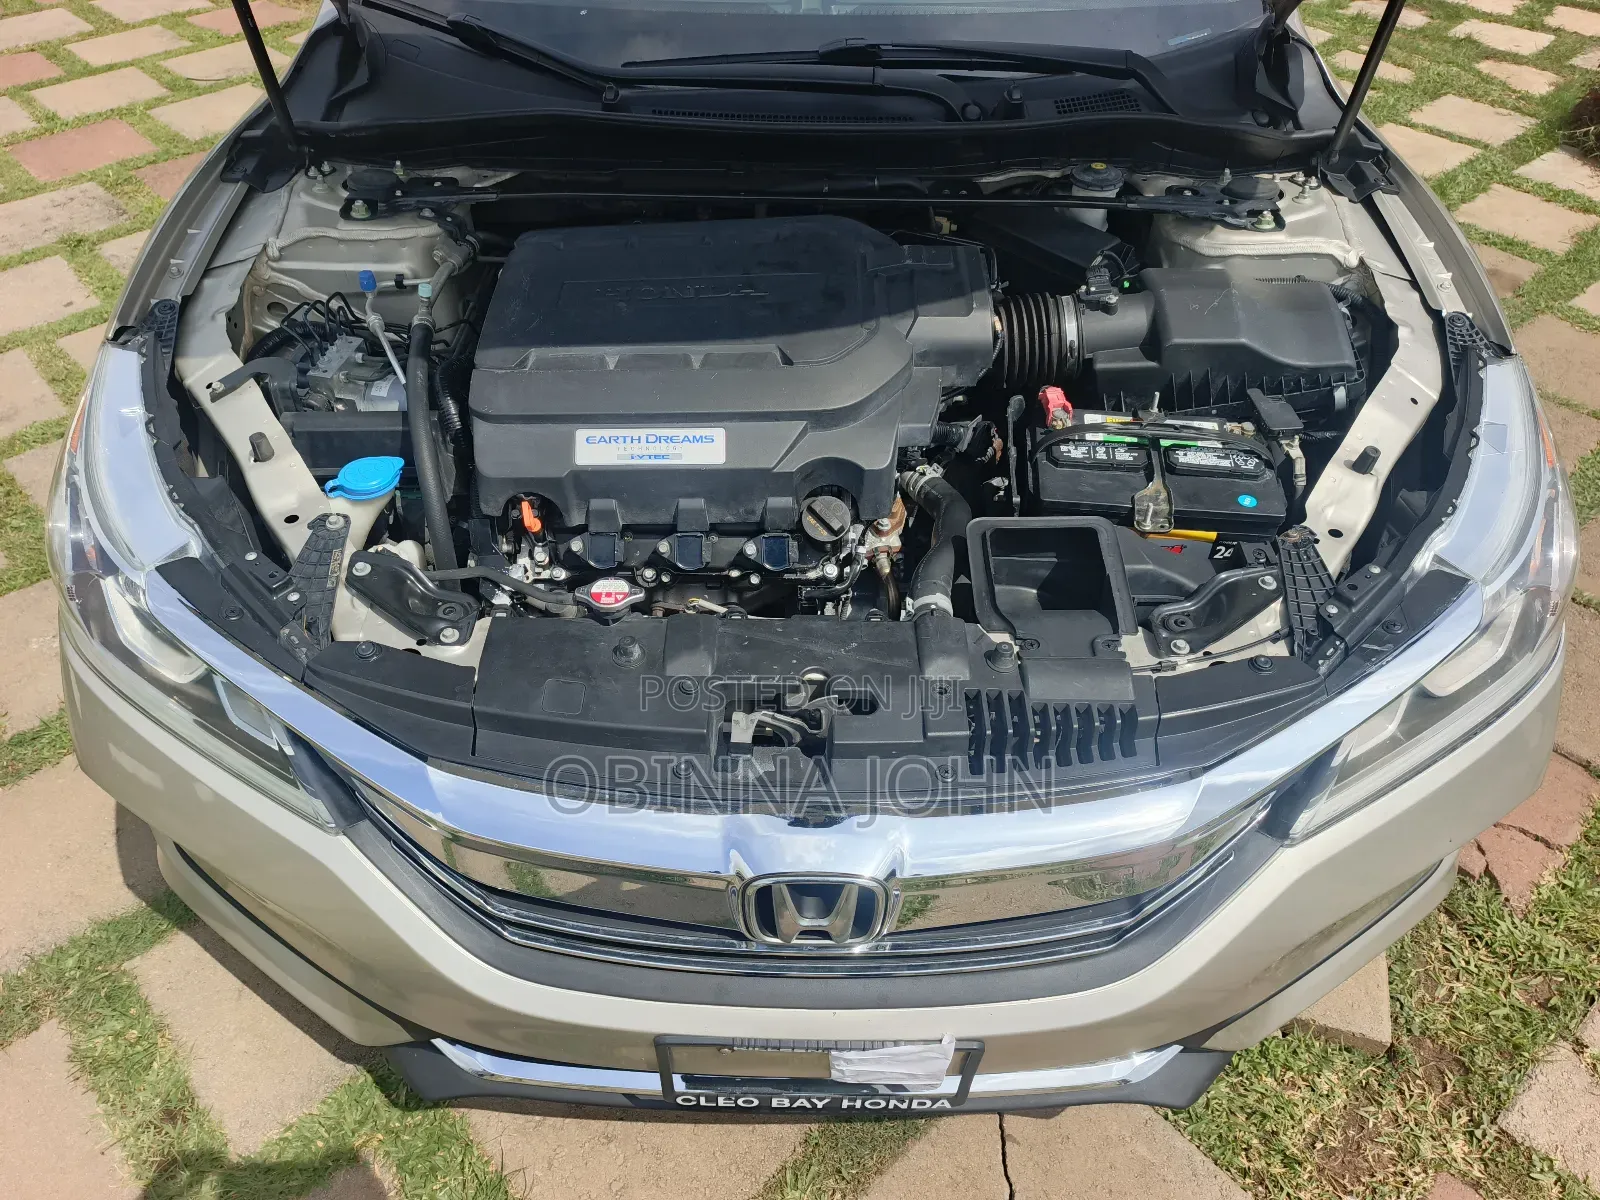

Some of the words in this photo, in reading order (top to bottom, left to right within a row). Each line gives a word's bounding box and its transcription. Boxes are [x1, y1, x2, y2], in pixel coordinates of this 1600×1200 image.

[585, 435, 641, 445] EARTH
[645, 433, 715, 444] DREAMS
[675, 1095, 760, 1108] CLEO
[771, 1096, 831, 1109] BAY
[841, 1097, 952, 1110] HONDA
